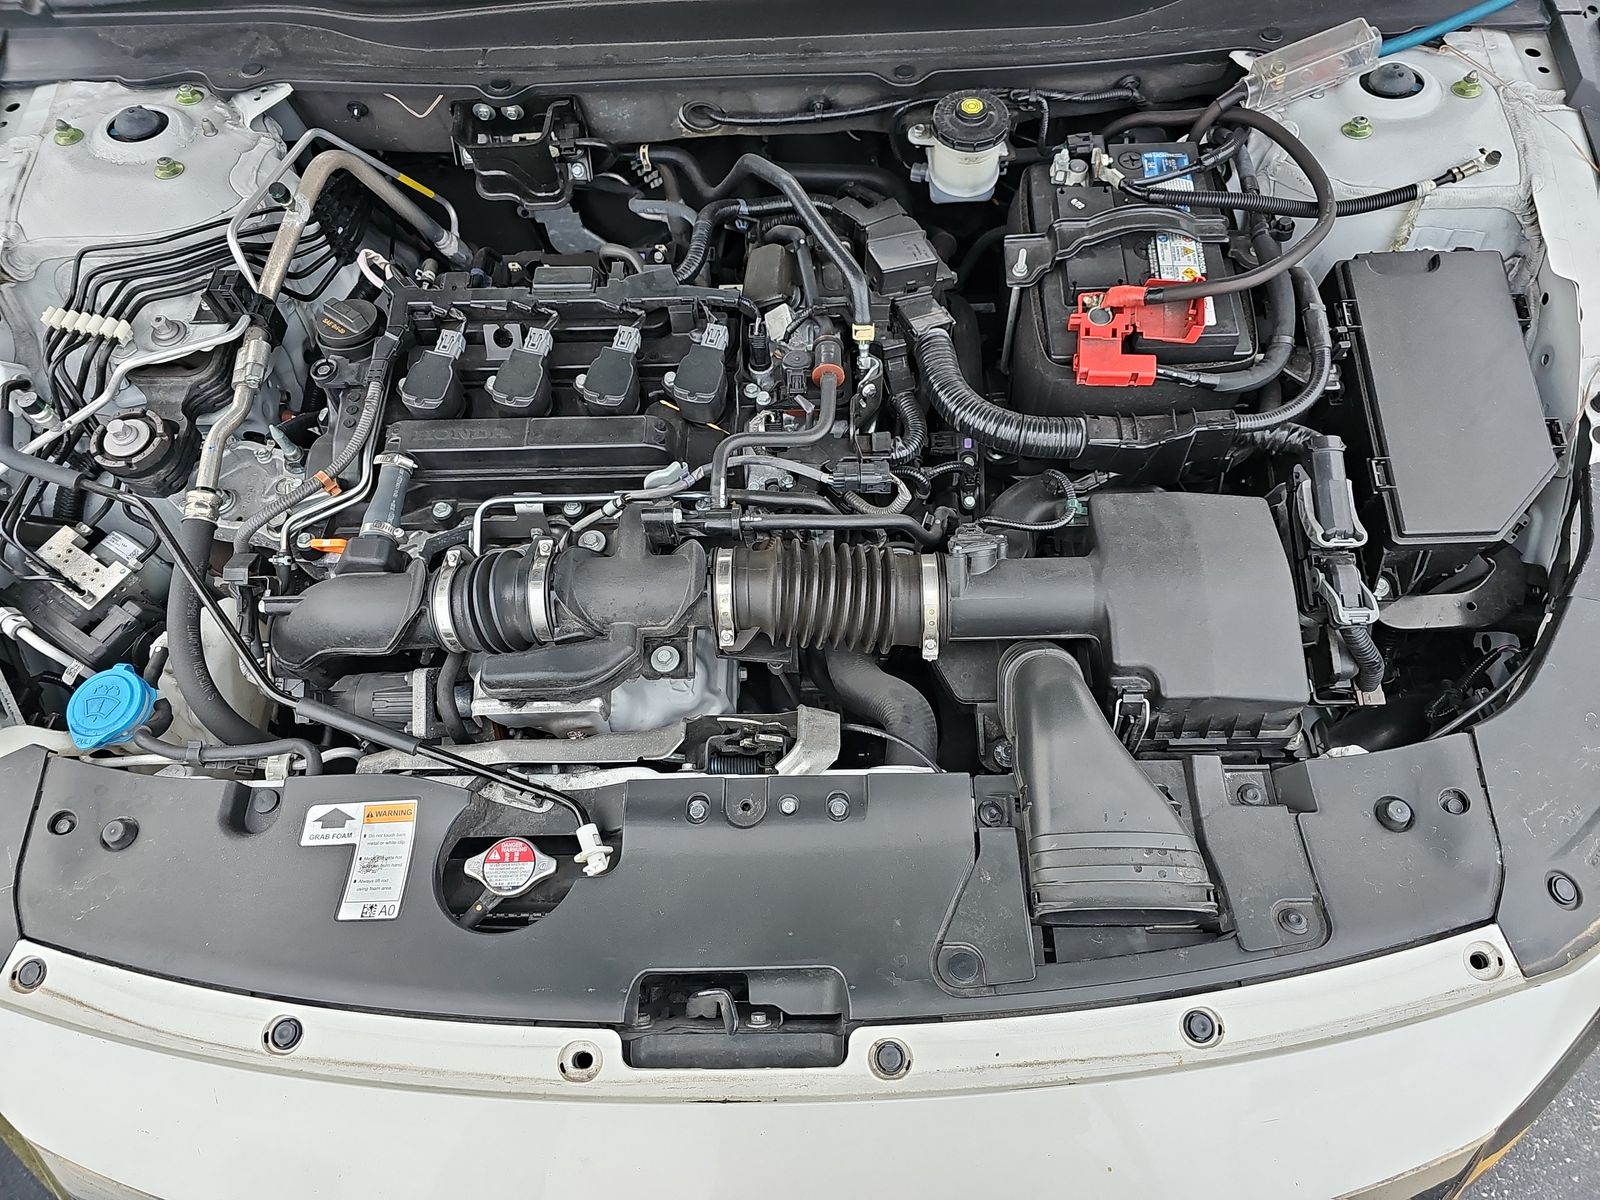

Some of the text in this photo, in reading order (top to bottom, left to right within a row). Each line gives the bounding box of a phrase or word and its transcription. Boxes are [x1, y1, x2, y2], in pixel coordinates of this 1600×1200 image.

[375, 808, 413, 818] WARNING
[309, 832, 353, 841] GRAB FOAM
[378, 904, 396, 917] A0
